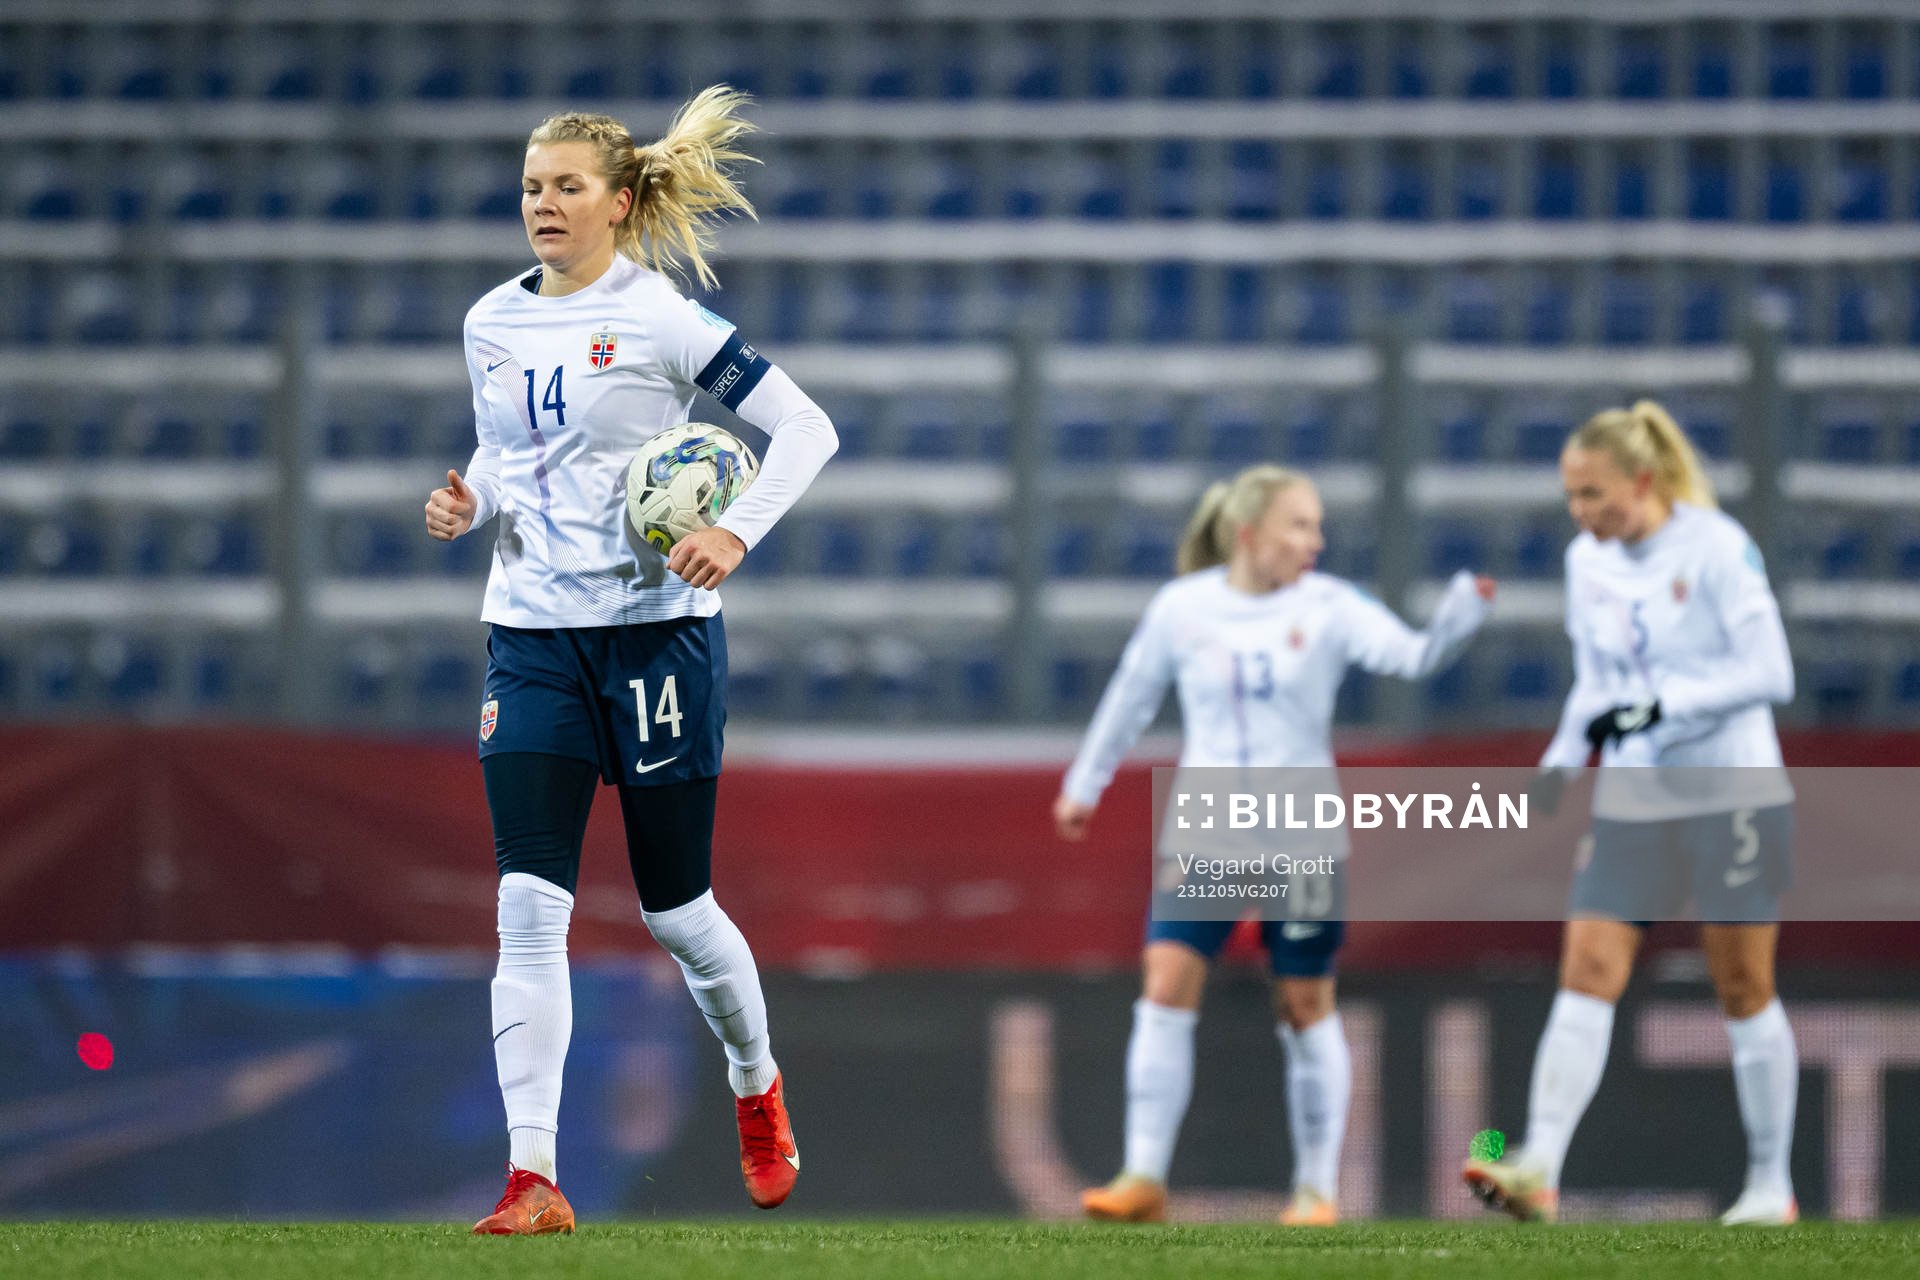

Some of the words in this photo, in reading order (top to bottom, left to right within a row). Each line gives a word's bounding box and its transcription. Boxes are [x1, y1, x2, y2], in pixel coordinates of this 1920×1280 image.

[524, 365, 566, 430] 14
[711, 364, 740, 399] ESPECT
[1231, 651, 1276, 702] 13
[629, 675, 684, 742] 14
[1731, 807, 1760, 865] 5
